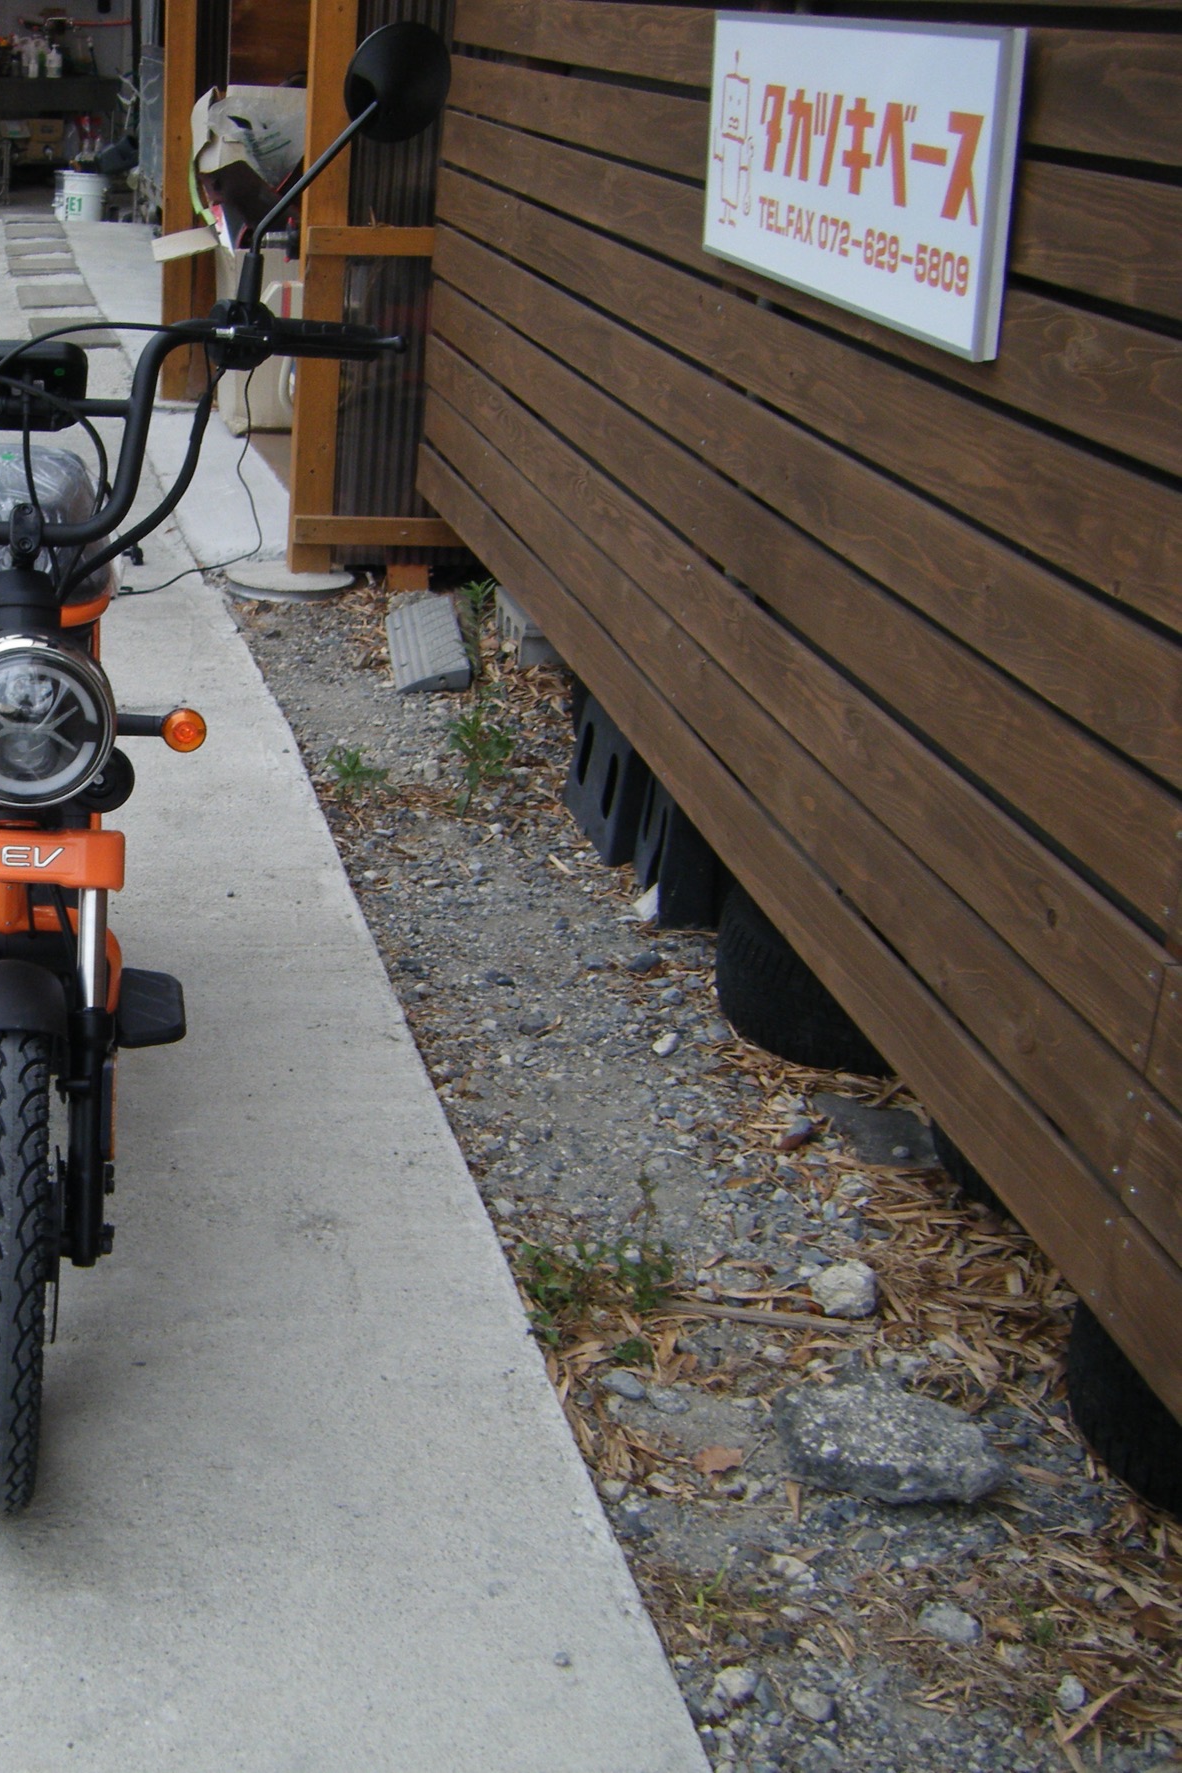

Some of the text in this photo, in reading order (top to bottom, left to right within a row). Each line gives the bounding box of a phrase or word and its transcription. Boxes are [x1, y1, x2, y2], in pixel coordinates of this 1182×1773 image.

[760, 84, 984, 226] タカツキベース
[818, 214, 970, 297] 072-629-5809
